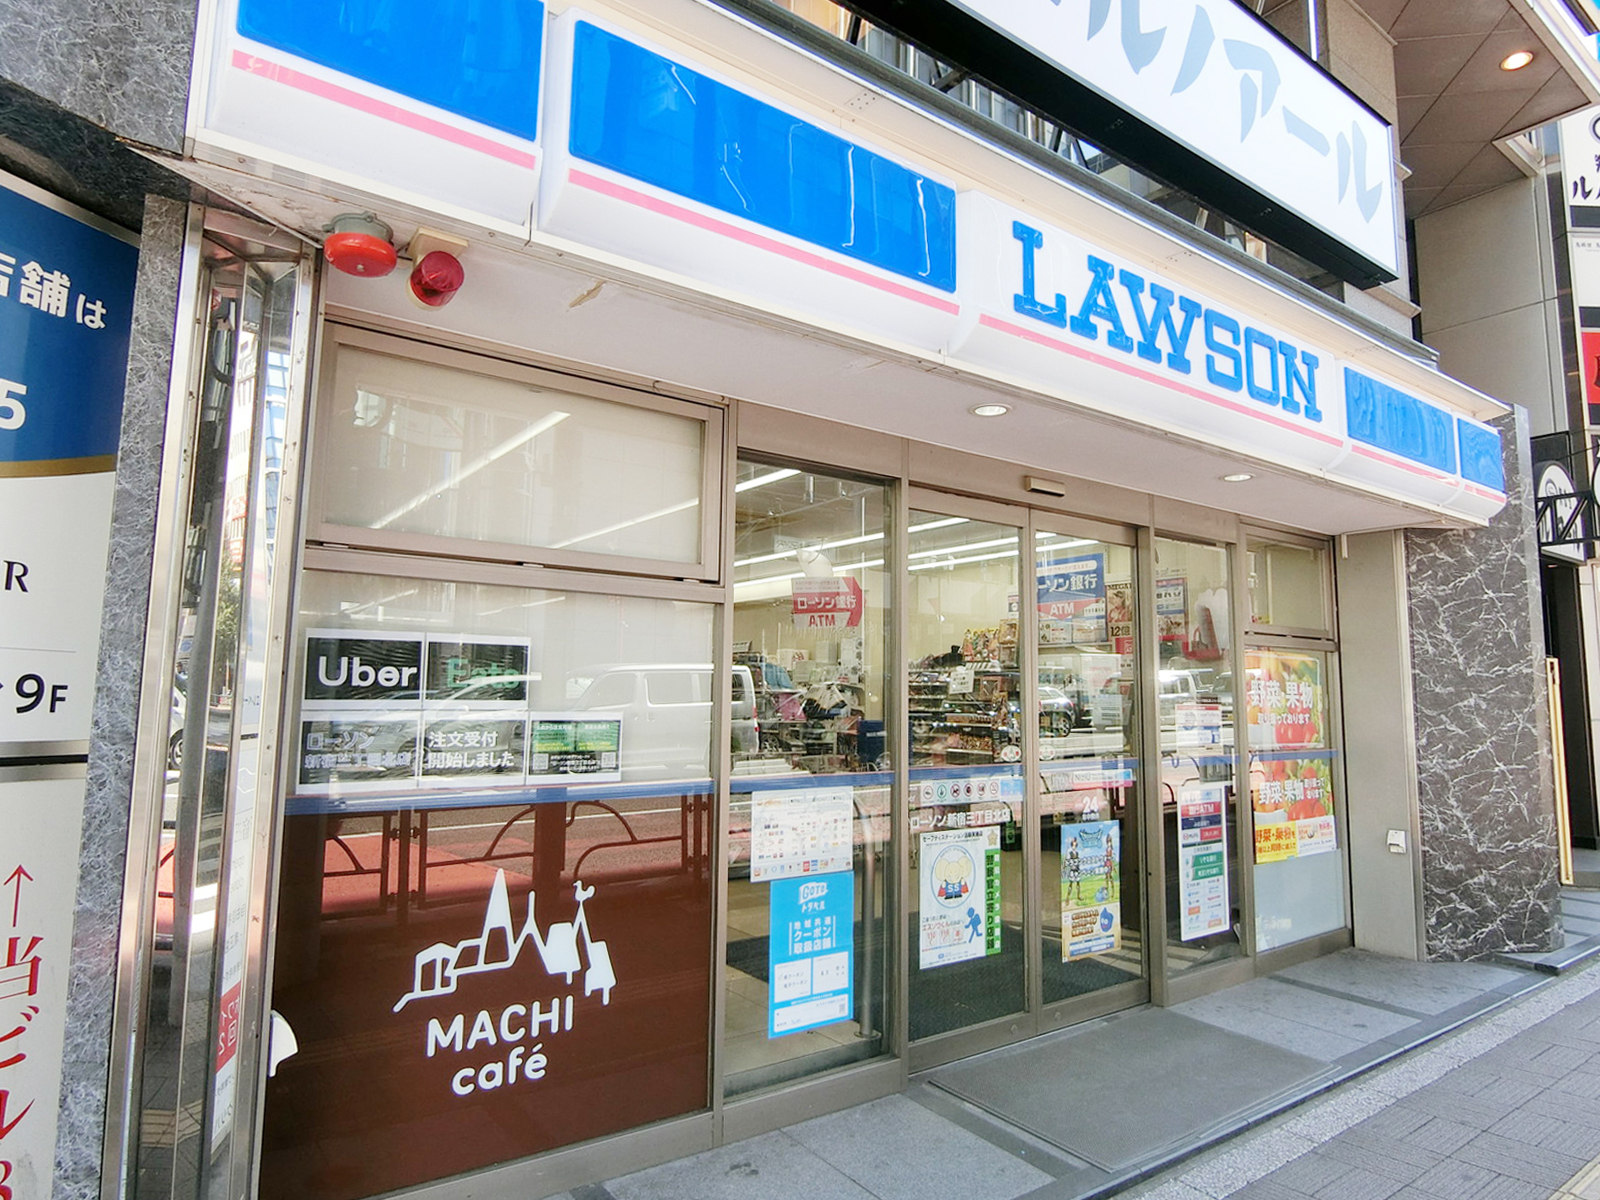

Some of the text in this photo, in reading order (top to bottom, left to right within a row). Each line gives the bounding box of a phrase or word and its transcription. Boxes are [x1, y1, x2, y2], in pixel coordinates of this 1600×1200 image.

[1012, 220, 1322, 423] LAWSON
[1037, 573, 1098, 592] ーソン銀行
[797, 595, 857, 609] ローソン銀行
[1050, 602, 1075, 616] ATM
[809, 614, 836, 627] ATM
[318, 656, 417, 688] Uber
[307, 731, 375, 750] ローソン
[427, 730, 499, 748] 注文受付
[426, 750, 515, 769] 開始しました
[793, 927, 832, 942] クーポン
[427, 996, 574, 1057] MACHI
[452, 1043, 548, 1095] café
